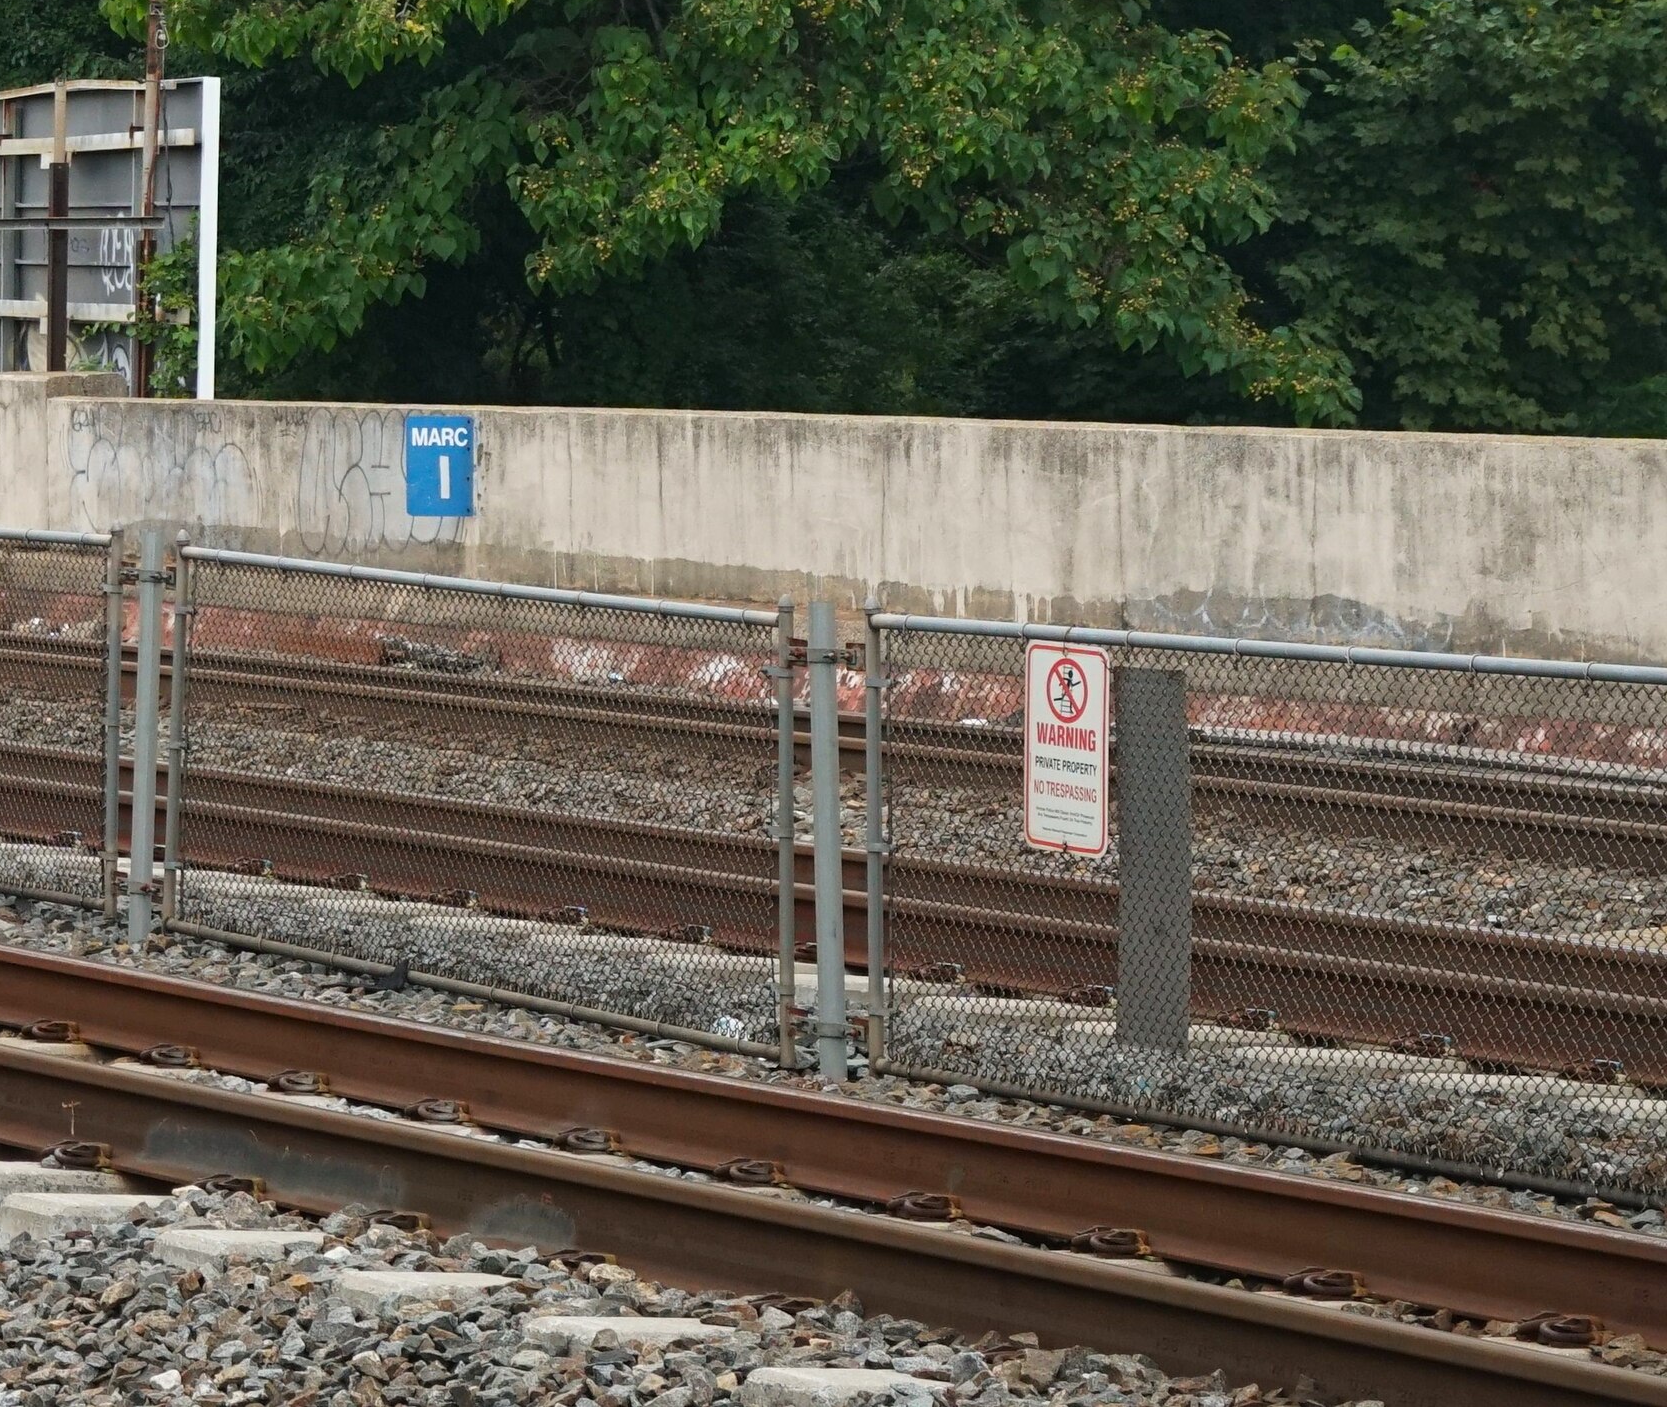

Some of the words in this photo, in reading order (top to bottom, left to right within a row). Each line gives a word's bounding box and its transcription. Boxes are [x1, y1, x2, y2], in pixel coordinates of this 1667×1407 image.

[411, 427, 468, 447] MARC
[1036, 722, 1096, 752] WARNING
[1035, 756, 1061, 771] PRIVATE
[1062, 760, 1097, 776] PROPERTY
[1034, 779, 1044, 794] NO
[1046, 781, 1097, 803] TRESPASSING
